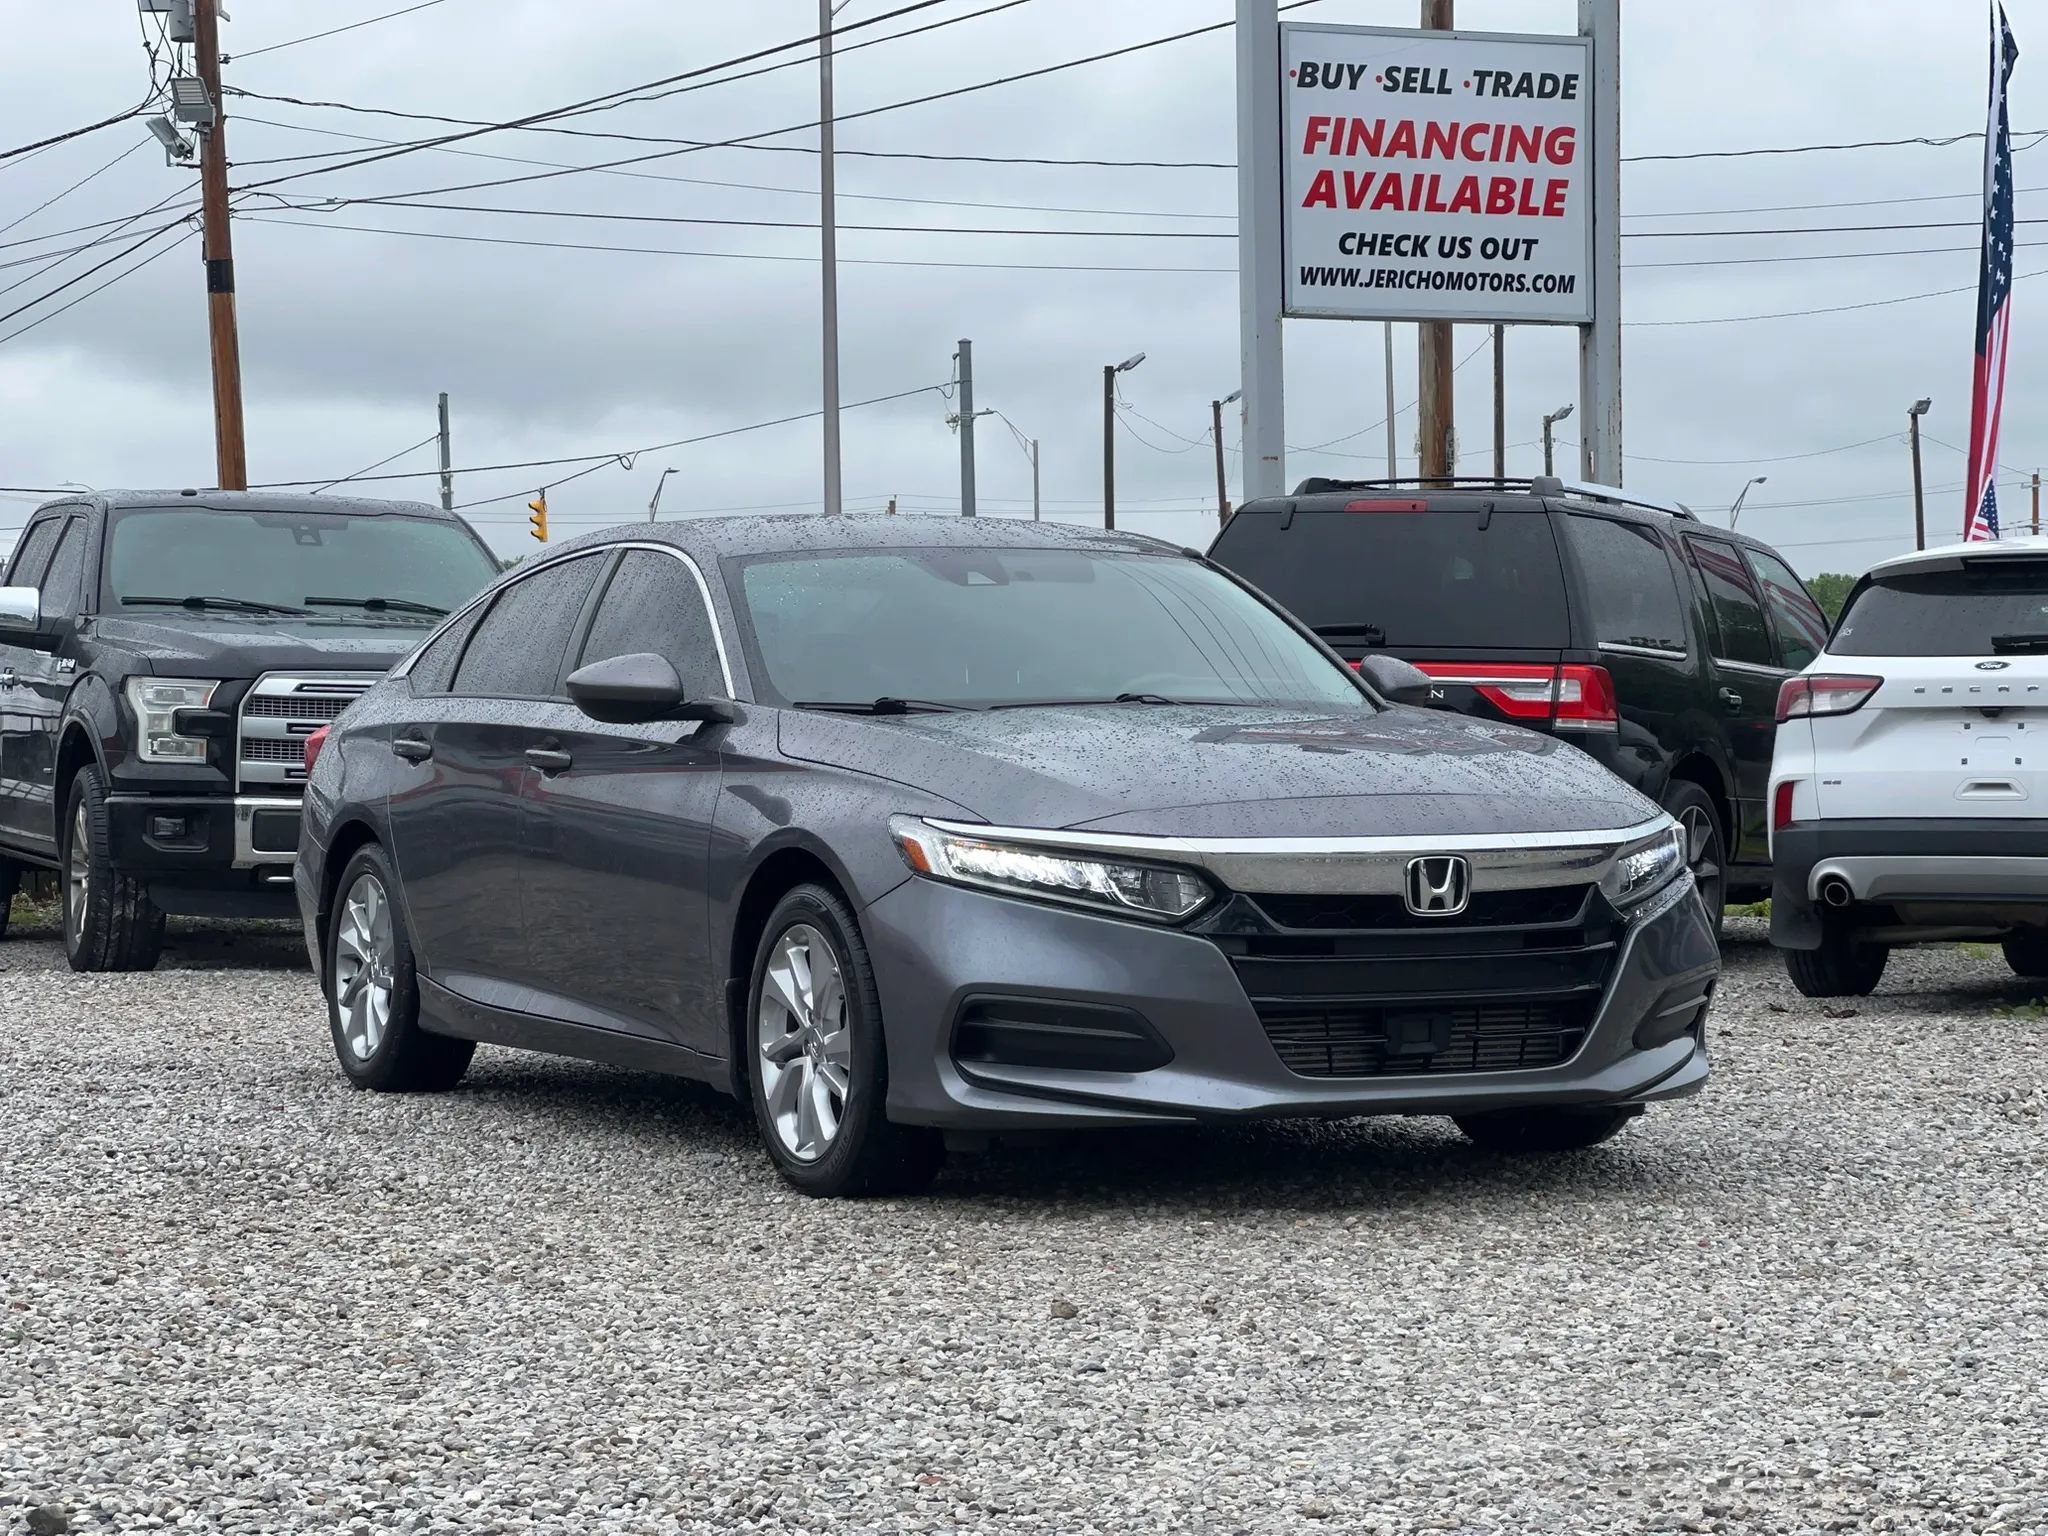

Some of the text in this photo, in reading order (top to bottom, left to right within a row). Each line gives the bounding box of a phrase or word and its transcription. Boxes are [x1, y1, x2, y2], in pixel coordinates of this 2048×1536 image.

[1302, 115, 1577, 165] FINANCING
[1301, 169, 1569, 217] AVAILABLE
[1338, 231, 1539, 261] CHECK US OUT
[1300, 265, 1575, 294] WWW.JERICHOMOTORS.COM
